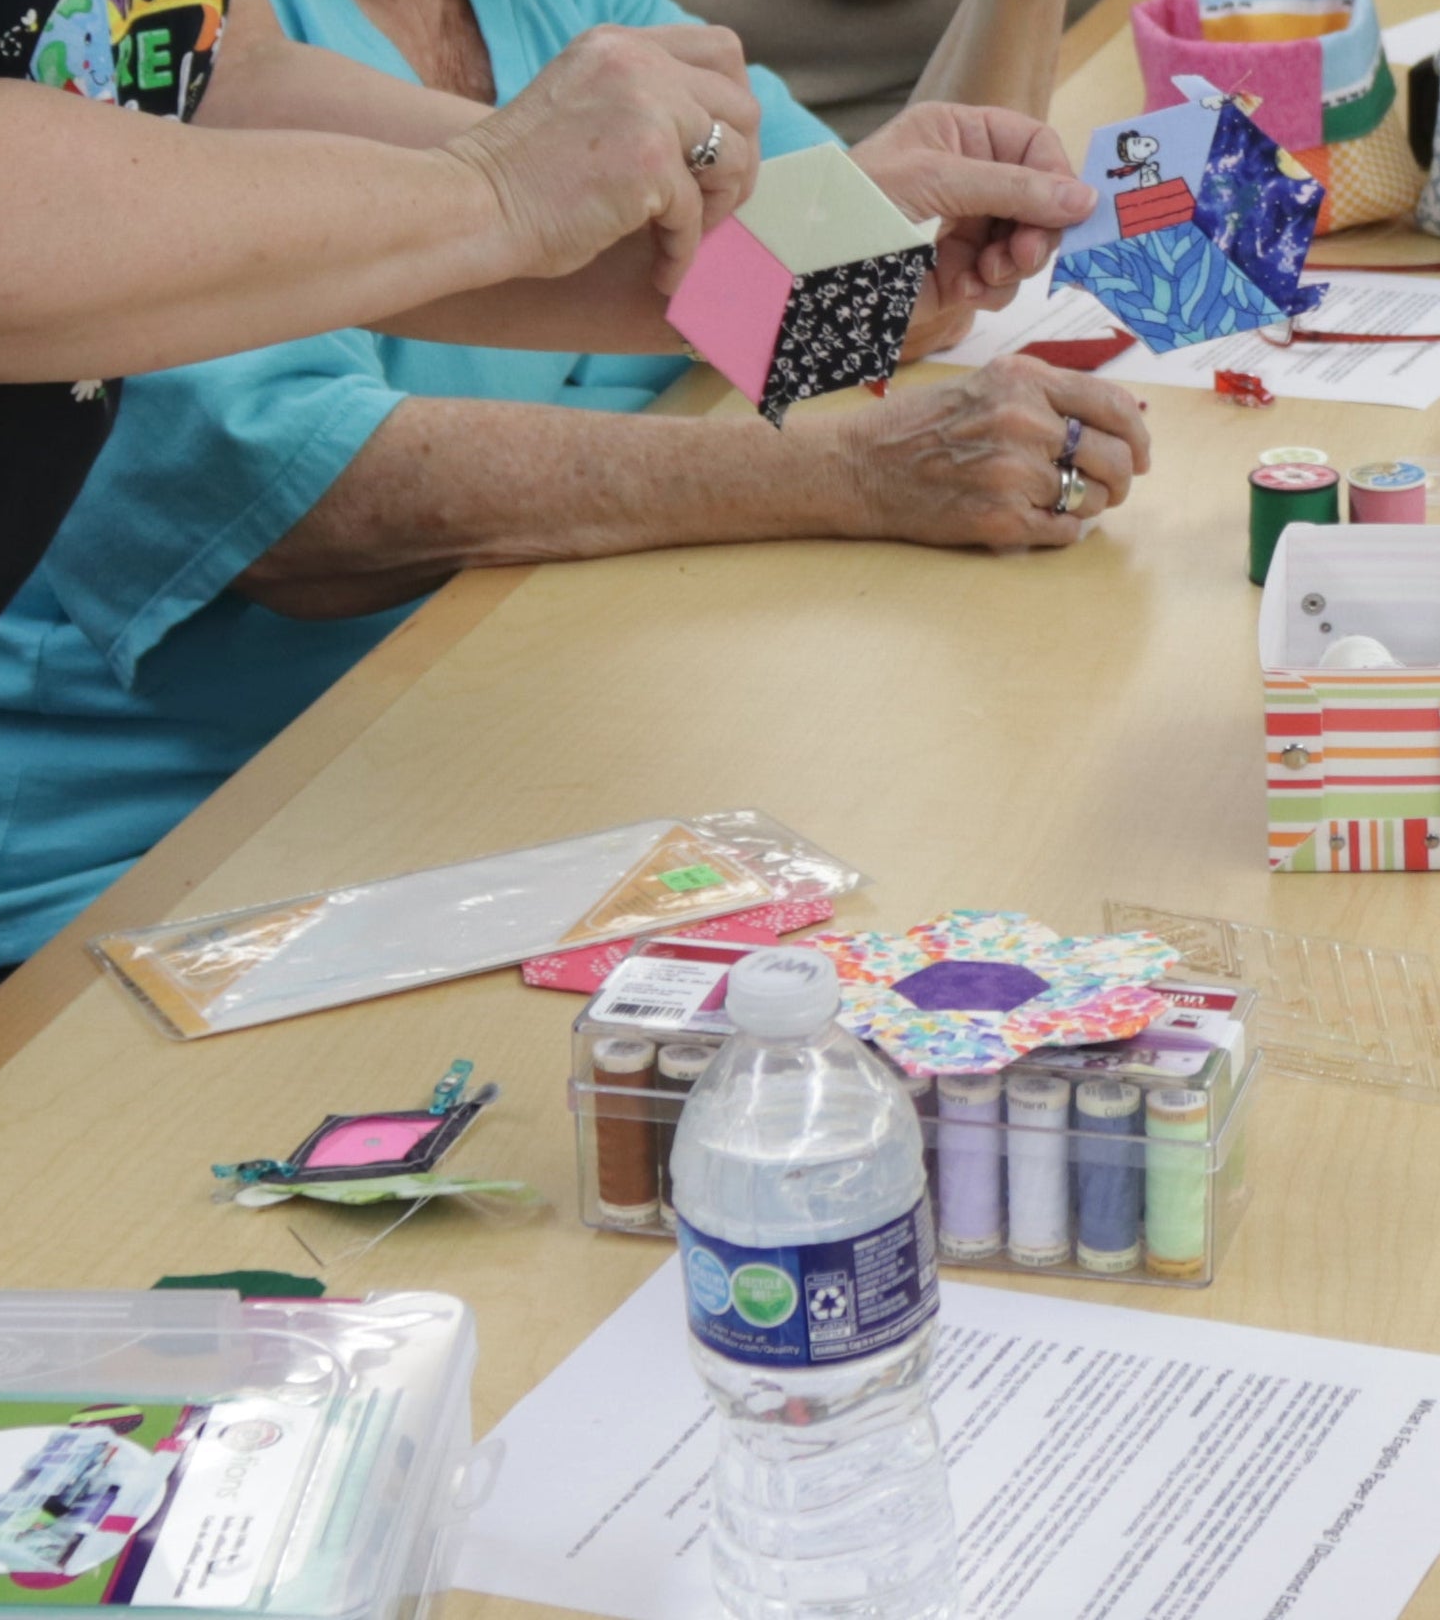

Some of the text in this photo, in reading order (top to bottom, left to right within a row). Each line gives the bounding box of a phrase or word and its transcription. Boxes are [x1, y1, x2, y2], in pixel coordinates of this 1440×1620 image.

[738, 1275, 783, 1291] RECYCLE
[1406, 1399, 1434, 1425] What
[1398, 1426, 1414, 1435] is
[1376, 1436, 1410, 1470] English
[1355, 1472, 1385, 1501] Paper
[1322, 1502, 1364, 1543] Piecing?
[1286, 1544, 1333, 1594] (Diamond
